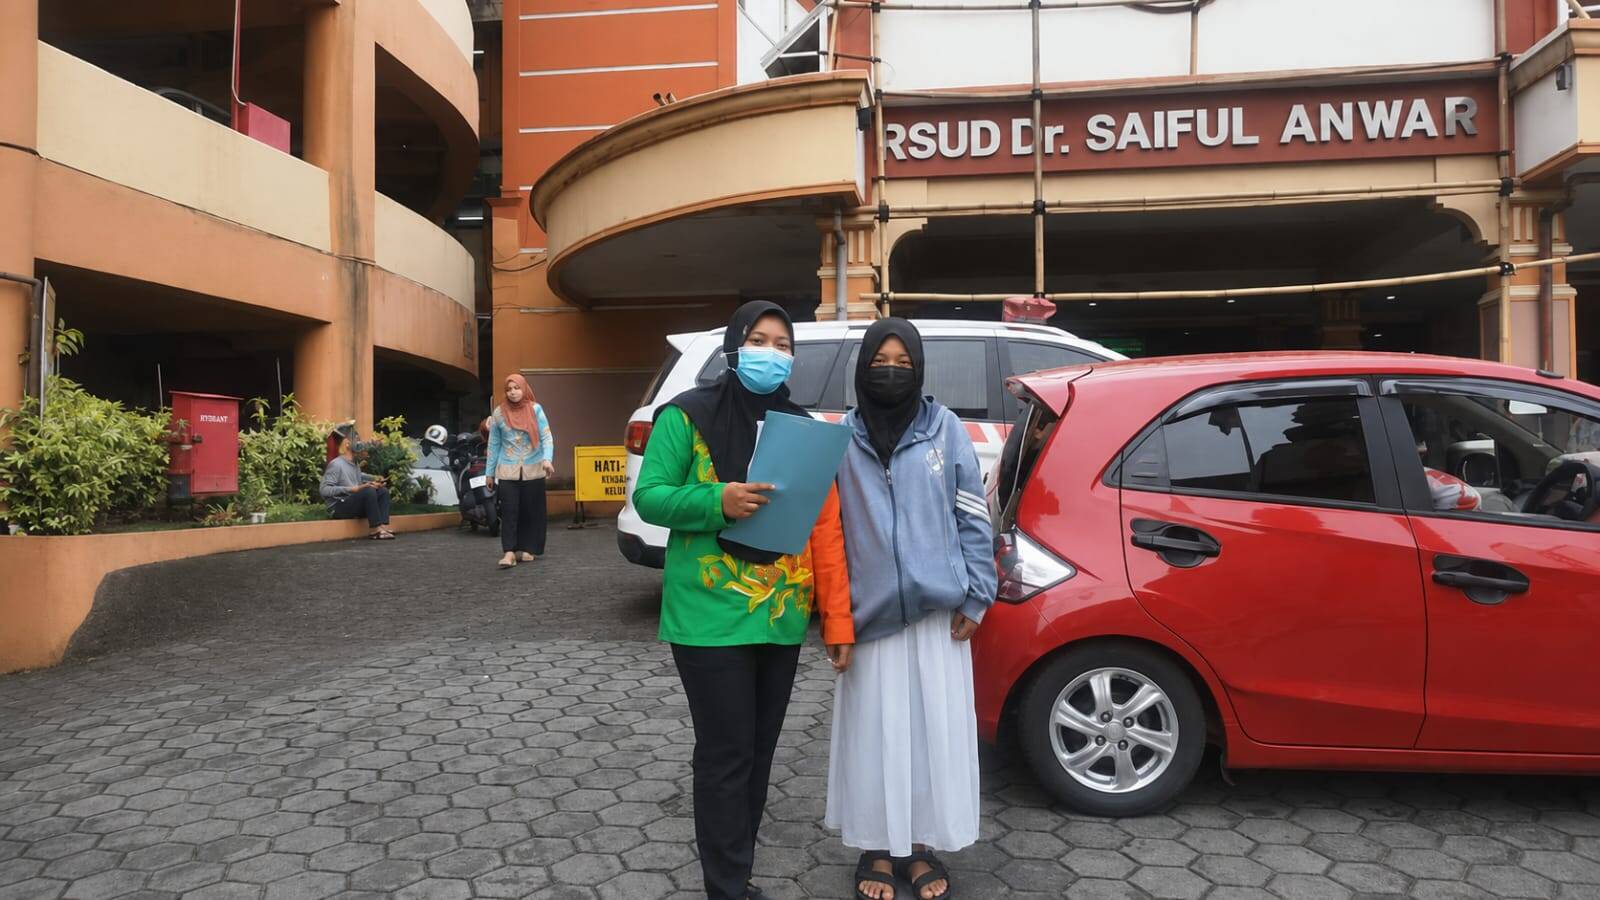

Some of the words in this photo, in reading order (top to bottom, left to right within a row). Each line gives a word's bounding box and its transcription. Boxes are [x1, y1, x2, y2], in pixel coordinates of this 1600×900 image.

[884, 120, 1000, 160] RSUD
[1012, 118, 1069, 155] Dr.
[1086, 107, 1260, 151] SAIFUL
[1280, 97, 1478, 143] ANWAR
[594, 460, 625, 472] HATI-
